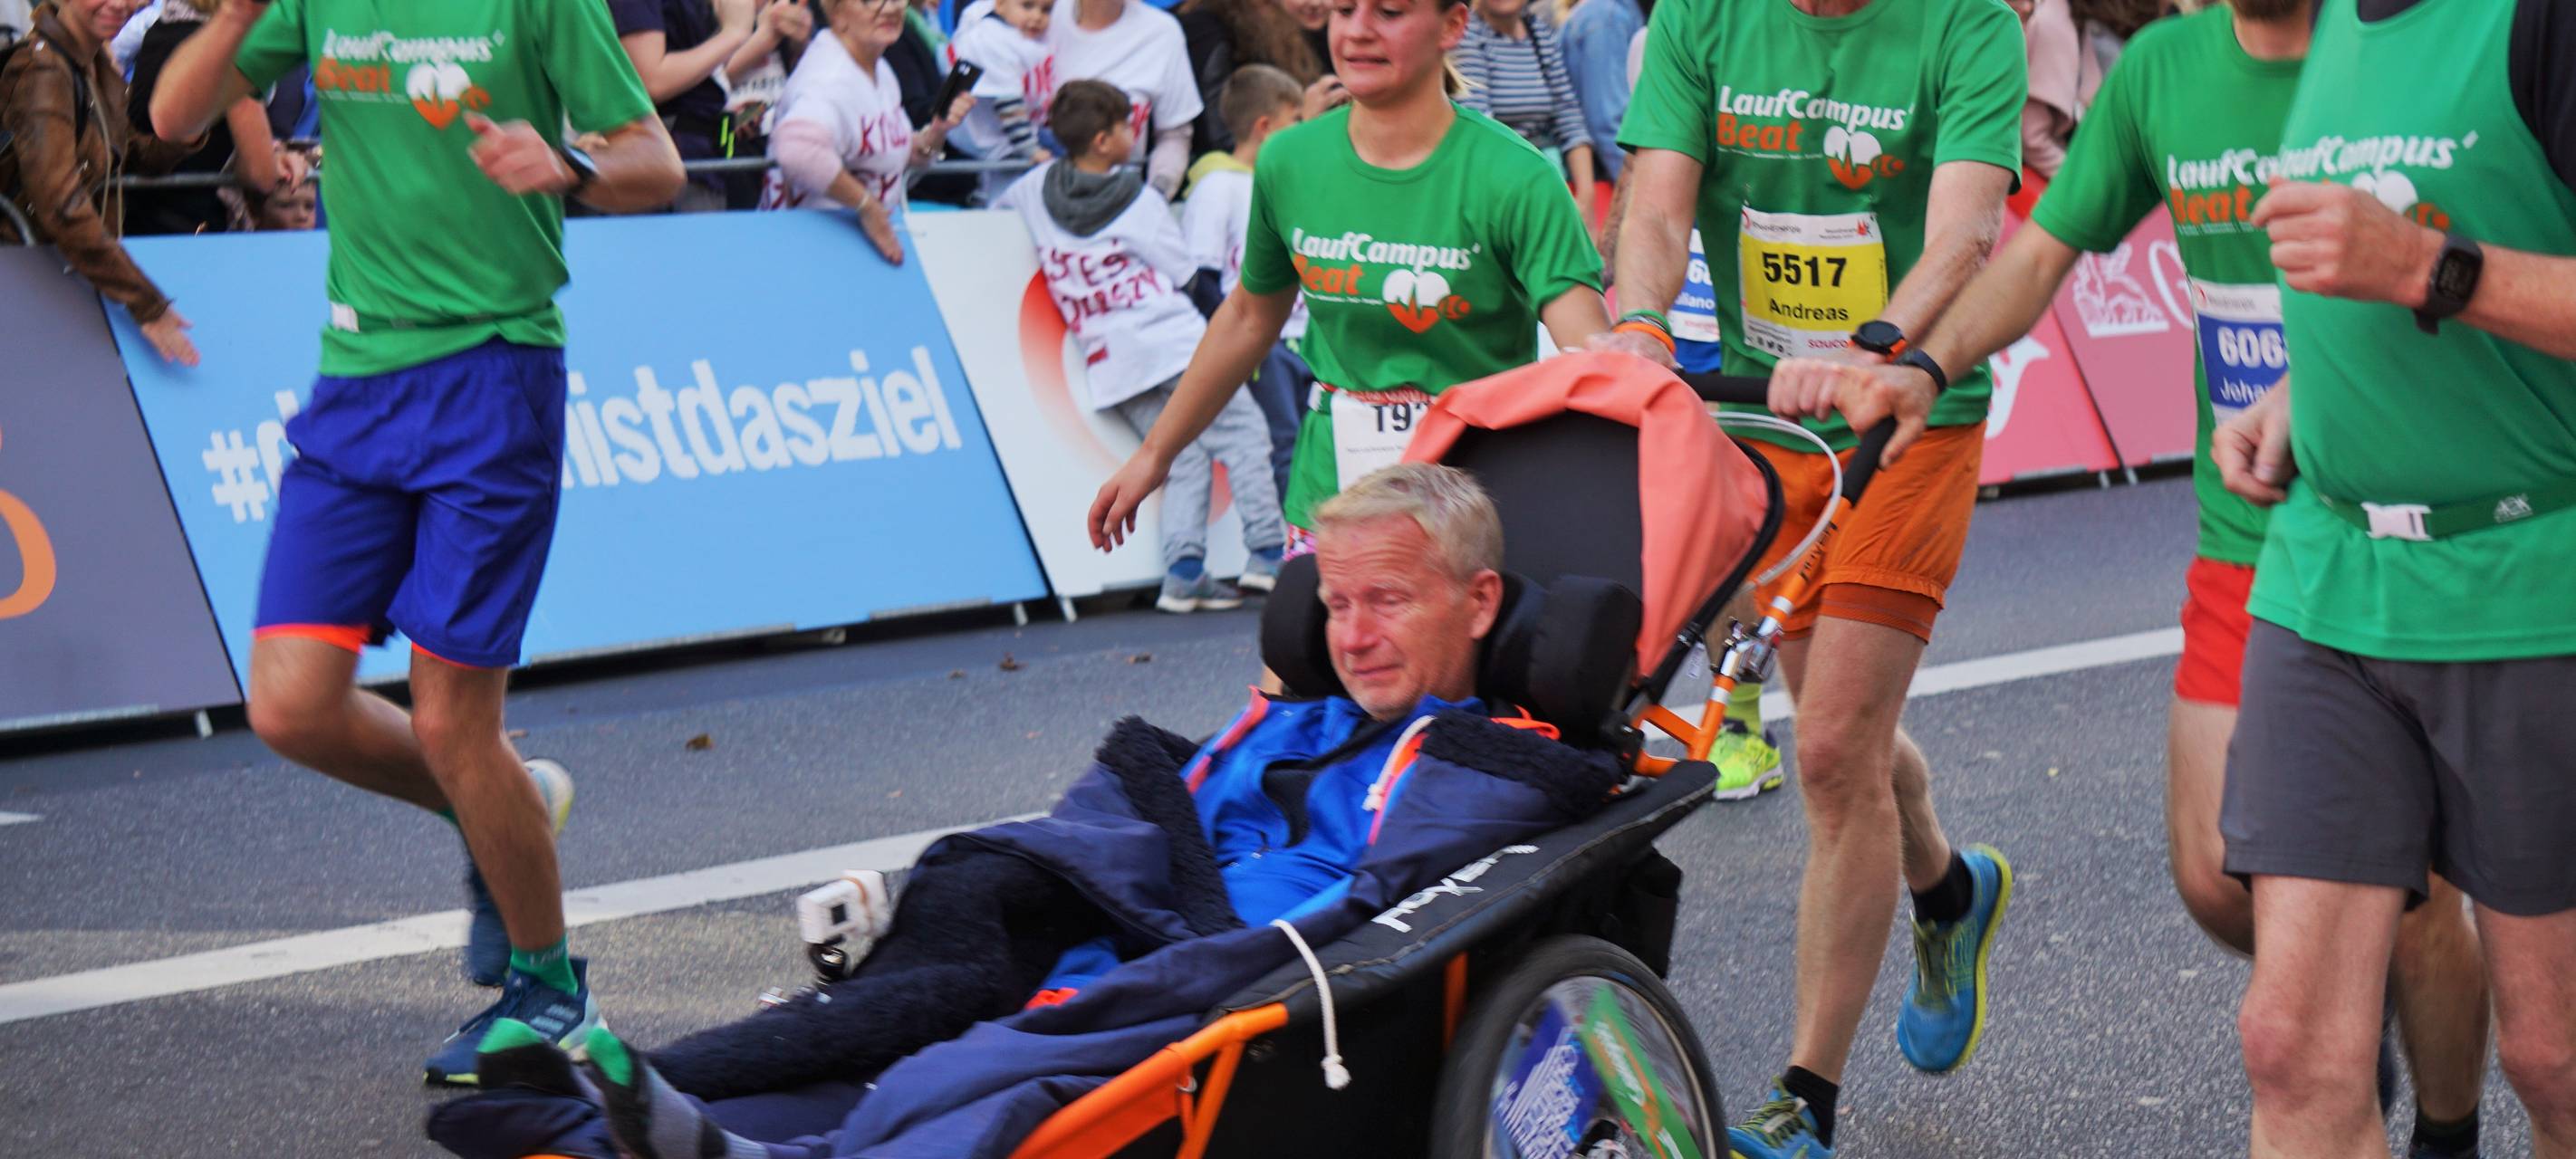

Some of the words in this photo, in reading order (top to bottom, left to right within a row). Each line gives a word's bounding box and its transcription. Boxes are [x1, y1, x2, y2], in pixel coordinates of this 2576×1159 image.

[1716, 112, 1804, 151] Beat
[2170, 185, 2253, 226] Beat
[1762, 251, 1847, 288] 5517
[1770, 298, 1850, 321] Andreas
[2217, 326, 2290, 369] 606
